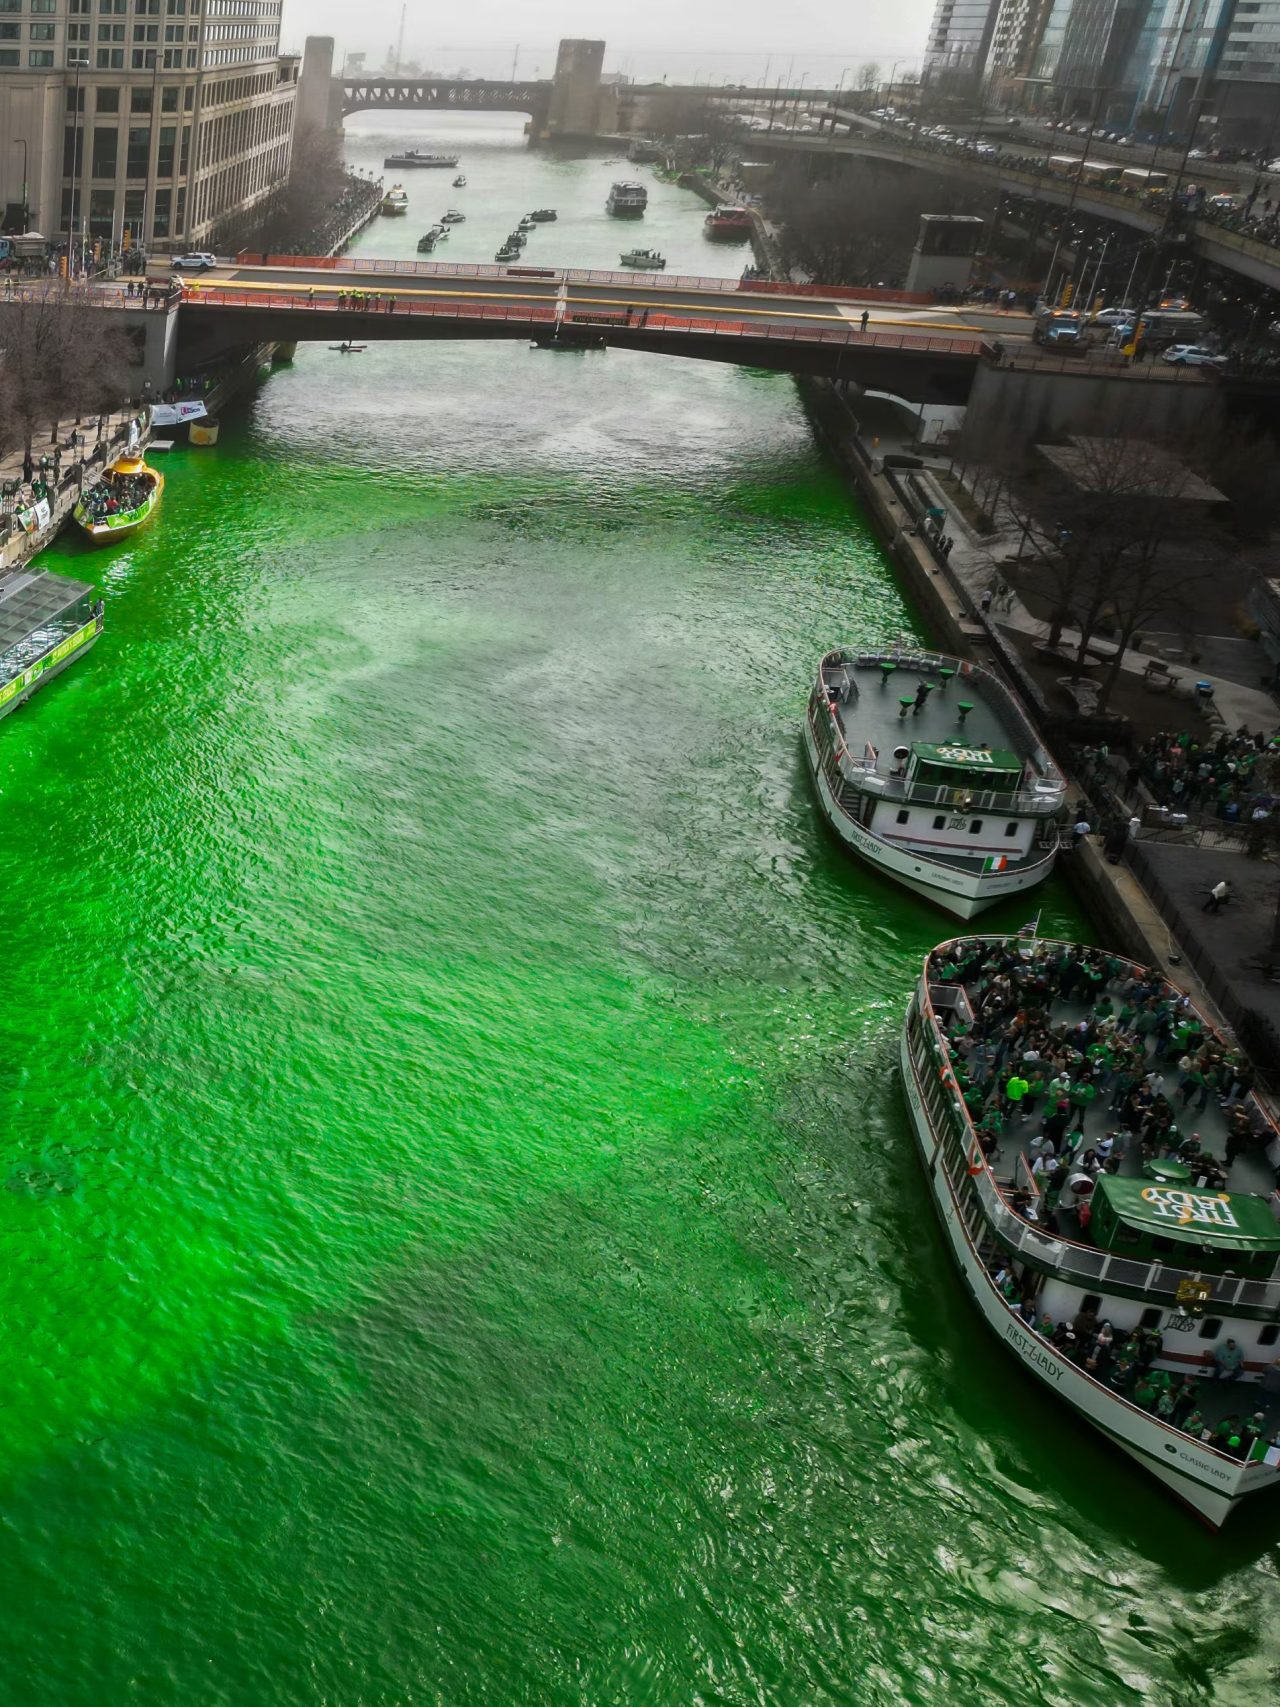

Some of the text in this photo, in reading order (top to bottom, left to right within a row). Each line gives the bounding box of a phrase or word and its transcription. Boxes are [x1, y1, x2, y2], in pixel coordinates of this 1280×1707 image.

[1036, 1352, 1064, 1381] LADY
[1179, 1452, 1209, 1471] CLASSIC
[1210, 1467, 1232, 1481] LADY
